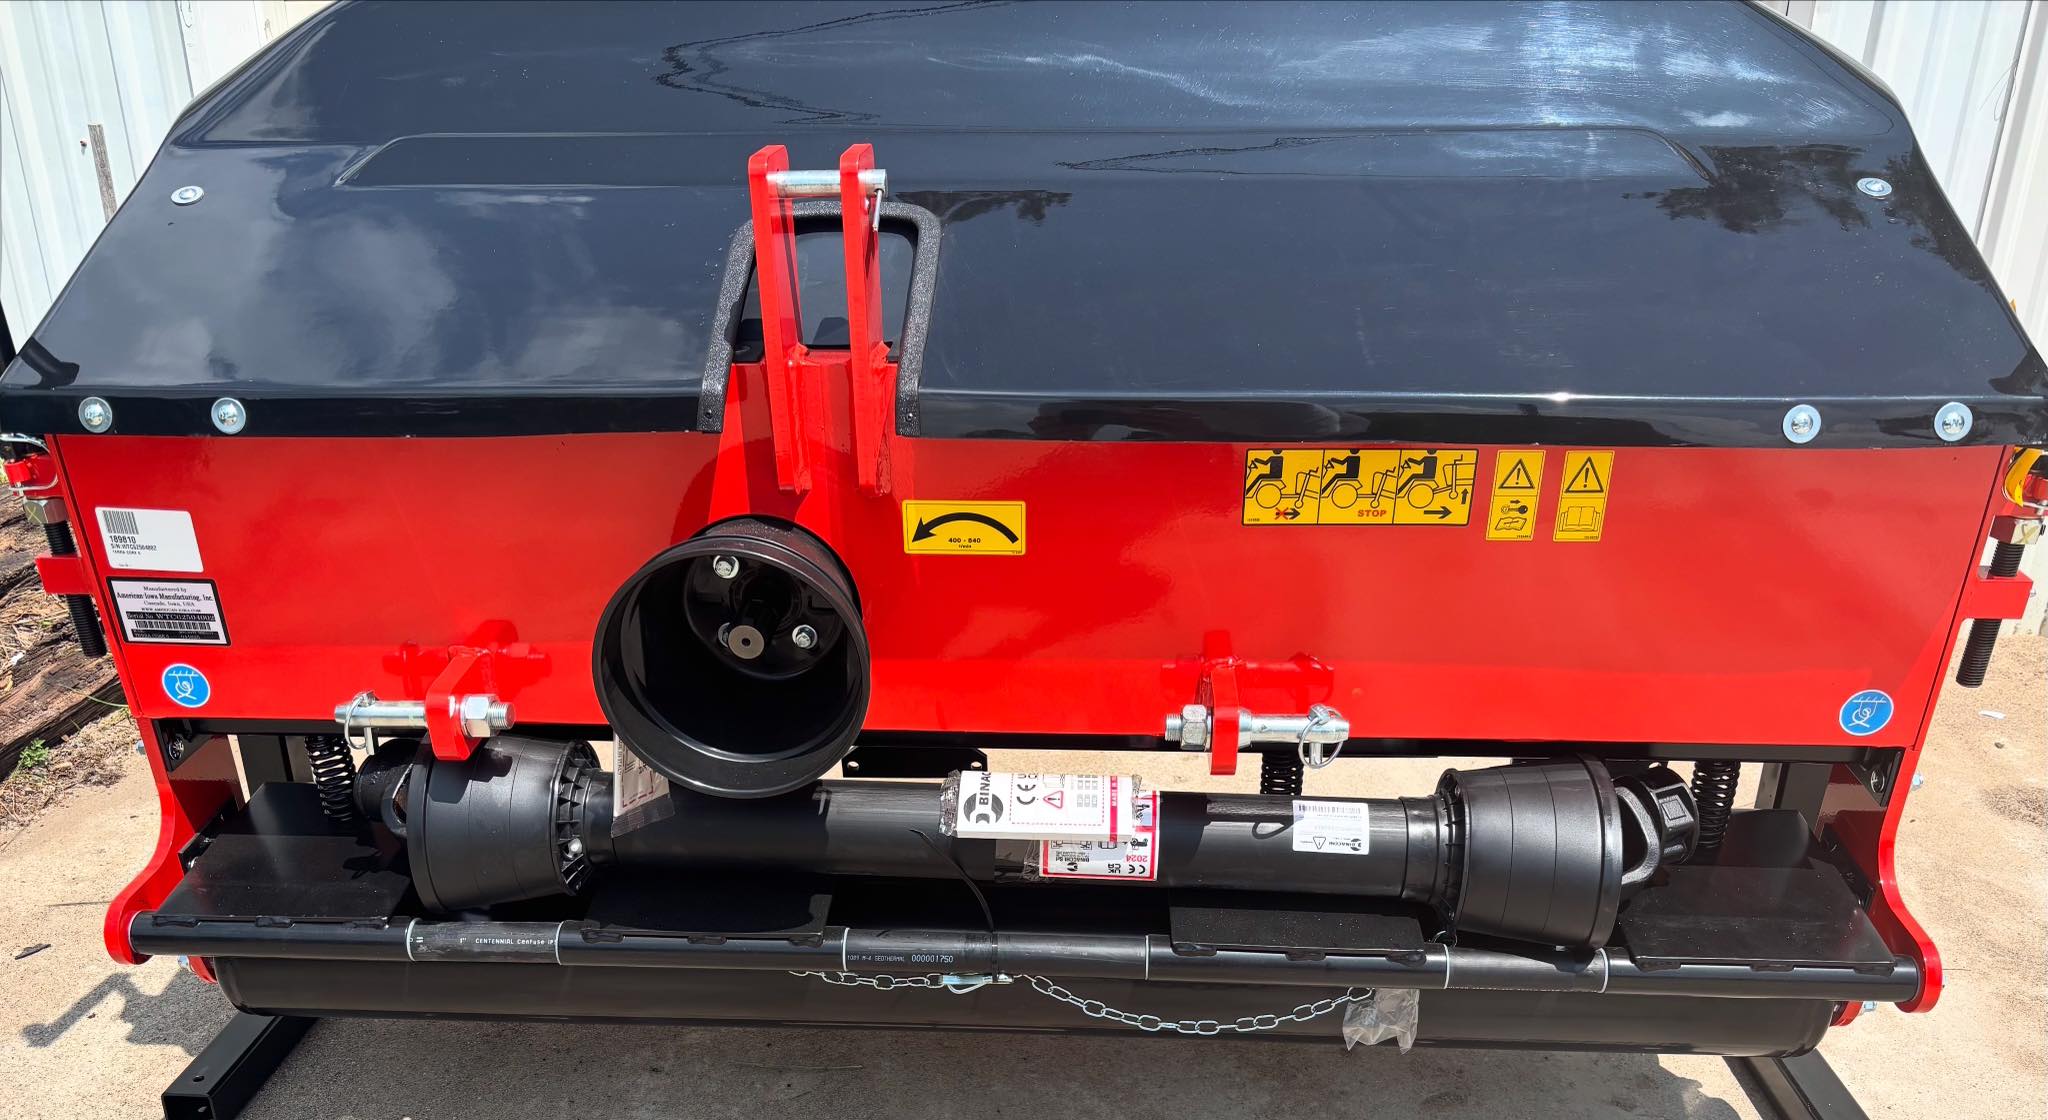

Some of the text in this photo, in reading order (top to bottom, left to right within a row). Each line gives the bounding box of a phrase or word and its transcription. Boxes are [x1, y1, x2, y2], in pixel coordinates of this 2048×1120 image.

[1357, 509, 1387, 518] STOP
[109, 535, 137, 544] 189810
[117, 592, 143, 600] American
[144, 592, 157, 600] Iowa
[1126, 854, 1148, 862] 2024
[475, 937, 514, 945] CENTENNIAL
[911, 954, 954, 963] 000001750
